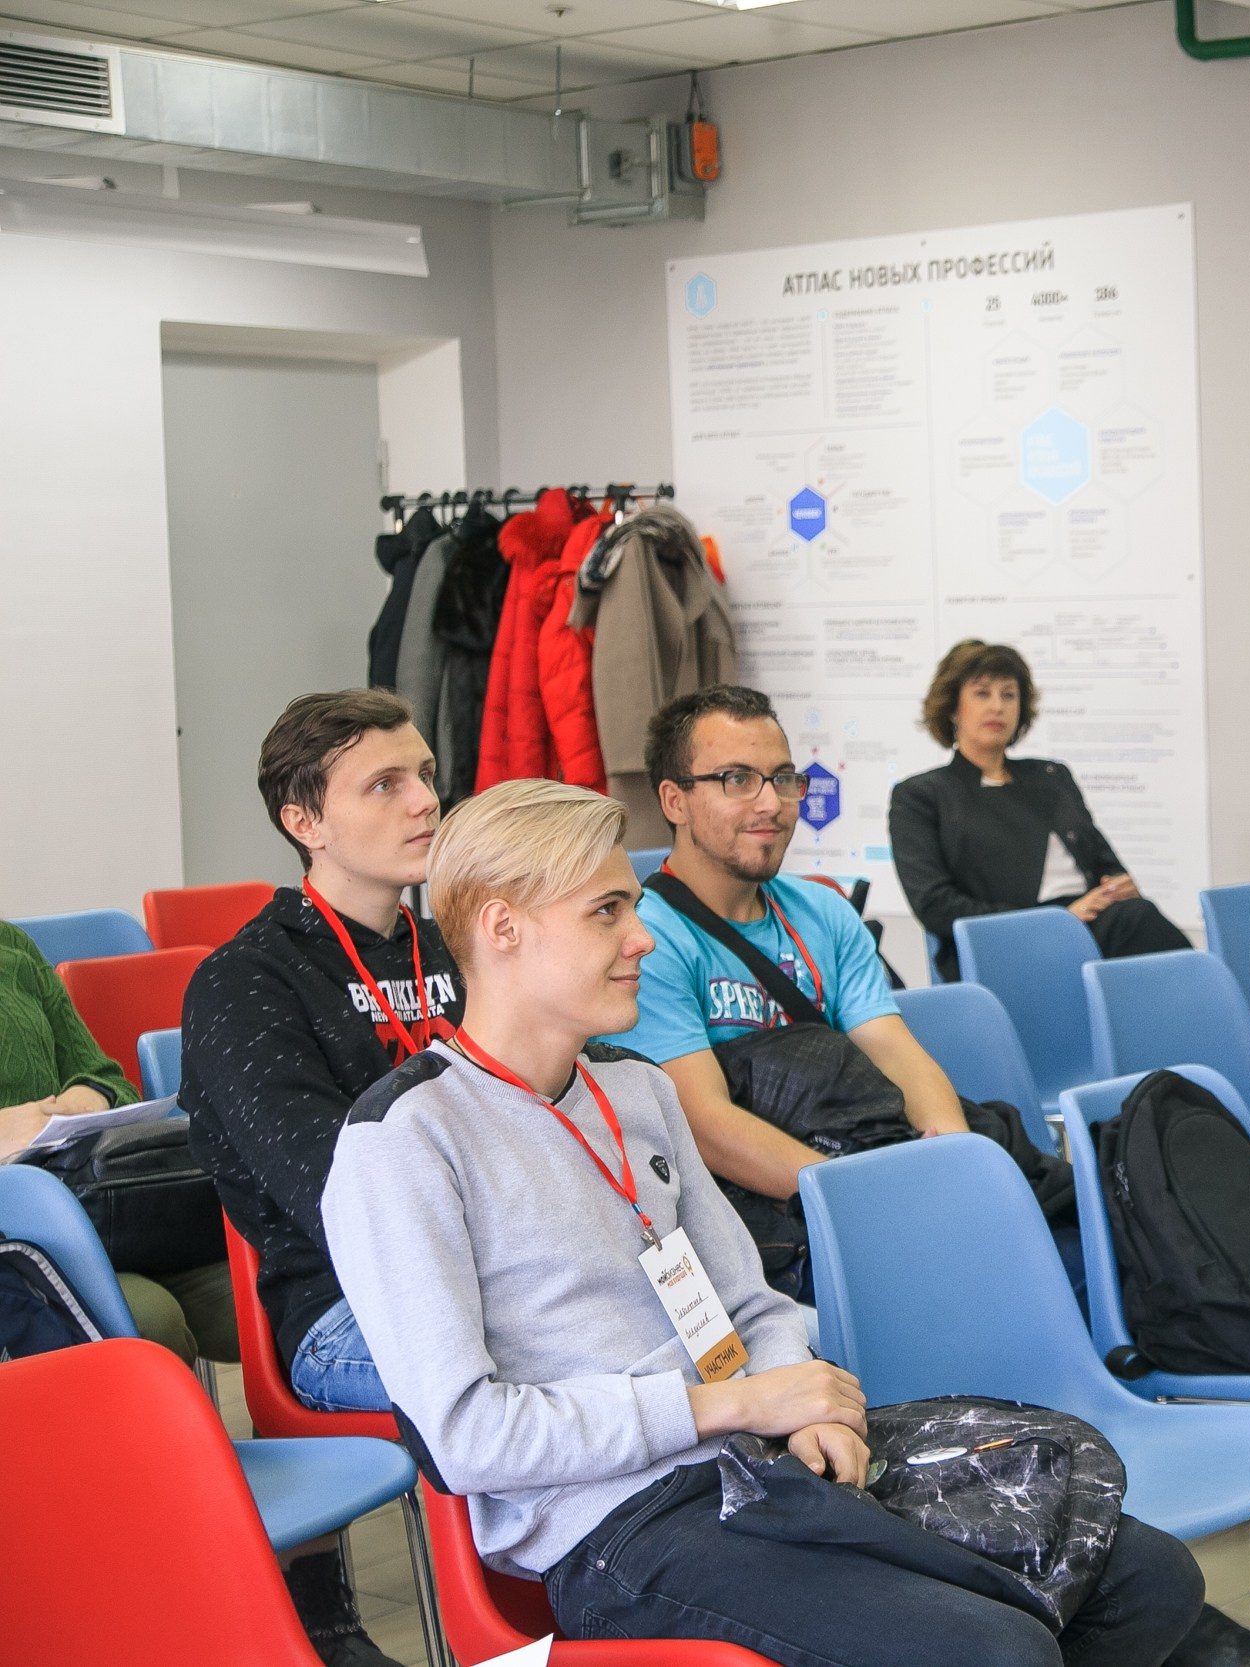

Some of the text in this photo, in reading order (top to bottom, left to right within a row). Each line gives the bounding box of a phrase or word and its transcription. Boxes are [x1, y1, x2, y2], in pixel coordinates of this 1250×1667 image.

[782, 241, 1056, 297] АТЛАС НОВЫХ ПРОФЕССИЙ
[704, 1343, 739, 1379] УЧАСТНИК
